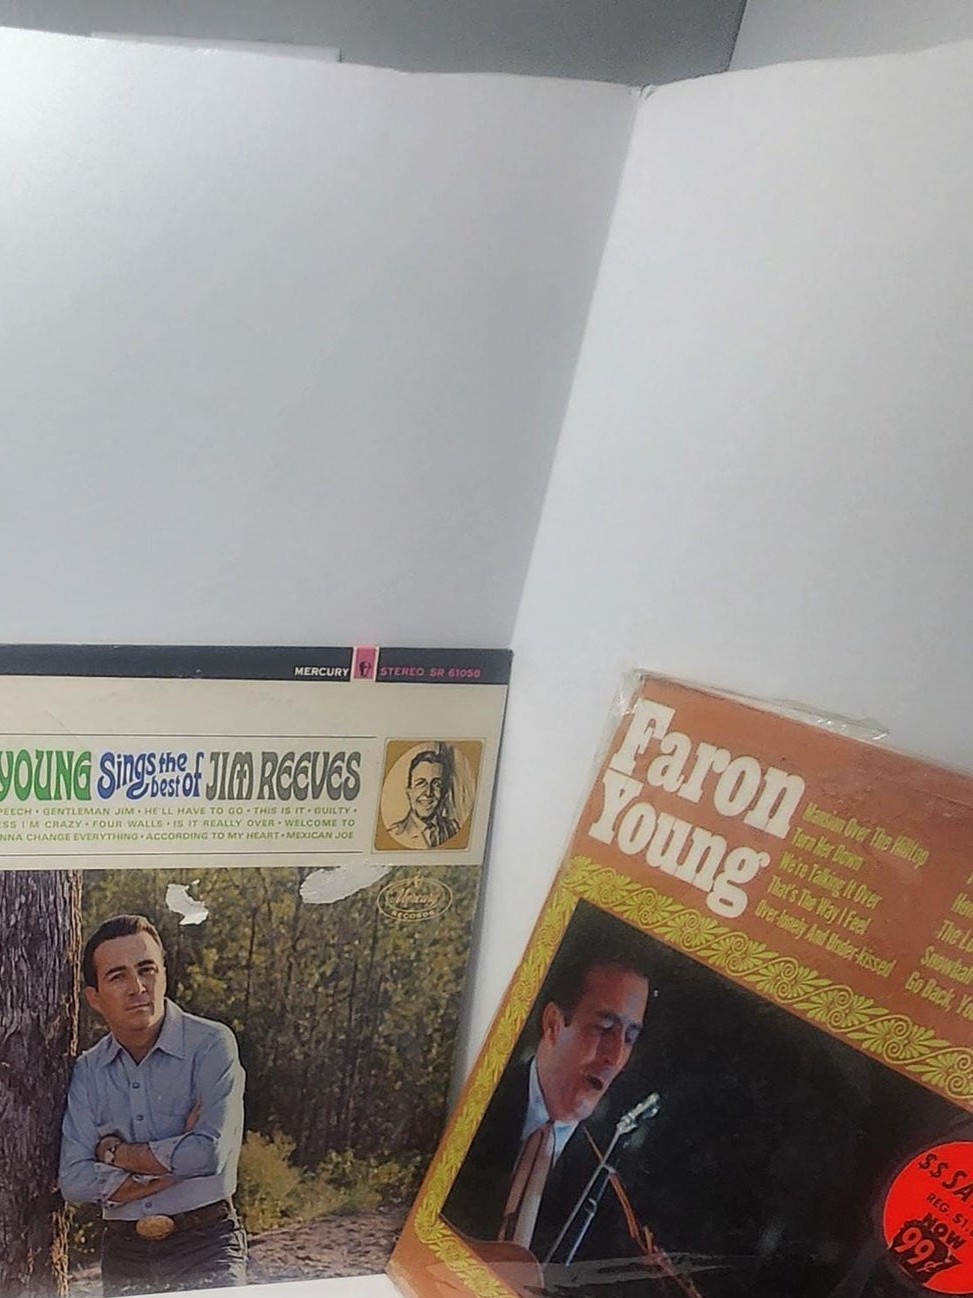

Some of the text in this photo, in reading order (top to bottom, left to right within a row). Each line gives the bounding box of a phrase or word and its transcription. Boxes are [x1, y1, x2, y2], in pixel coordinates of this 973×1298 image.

[295, 667, 350, 677] MERCURY
[380, 667, 424, 676] STEREO
[429, 668, 444, 677] SR
[97, 751, 156, 800] Sings
[159, 752, 187, 774] the
[182, 752, 204, 797] of
[206, 752, 253, 801] JIM
[257, 752, 361, 801] REEVES
[610, 697, 806, 839] Faron
[150, 775, 180, 797] best
[43, 808, 110, 816] GENTLEMAN
[115, 808, 134, 816] JIM
[145, 807, 173, 815] HE'LL
[177, 807, 206, 815] HAVE
[210, 807, 224, 815] TO
[228, 807, 244, 815] GO
[253, 807, 277, 815] THIS
[281, 807, 291, 815] IS
[296, 807, 304, 815] IT
[314, 807, 350, 815] GUILTY
[26, 834, 71, 842] CHANGE
[74, 834, 138, 842] EVERYTHING
[146, 832, 208, 840] ACCORDING
[212, 832, 224, 840] TO
[228, 832, 244, 840] MY
[246, 832, 279, 840] HEART
[286, 832, 332, 840] MEXICAN
[335, 832, 354, 840] JOE
[588, 769, 770, 918] Young
[844, 818, 870, 843] Over
[870, 826, 893, 850] The
[813, 836, 835, 858] Her
[832, 844, 864, 871] Down
[779, 851, 809, 878] We're
[807, 863, 847, 898] Talking
[853, 884, 883, 909] Over
[767, 875, 799, 902] That's
[816, 897, 841, 924] Way
[843, 910, 872, 935] Feel
[805, 924, 830, 946] And
[927, 1192, 950, 1216] REG.
[922, 1213, 967, 1250] NOW
